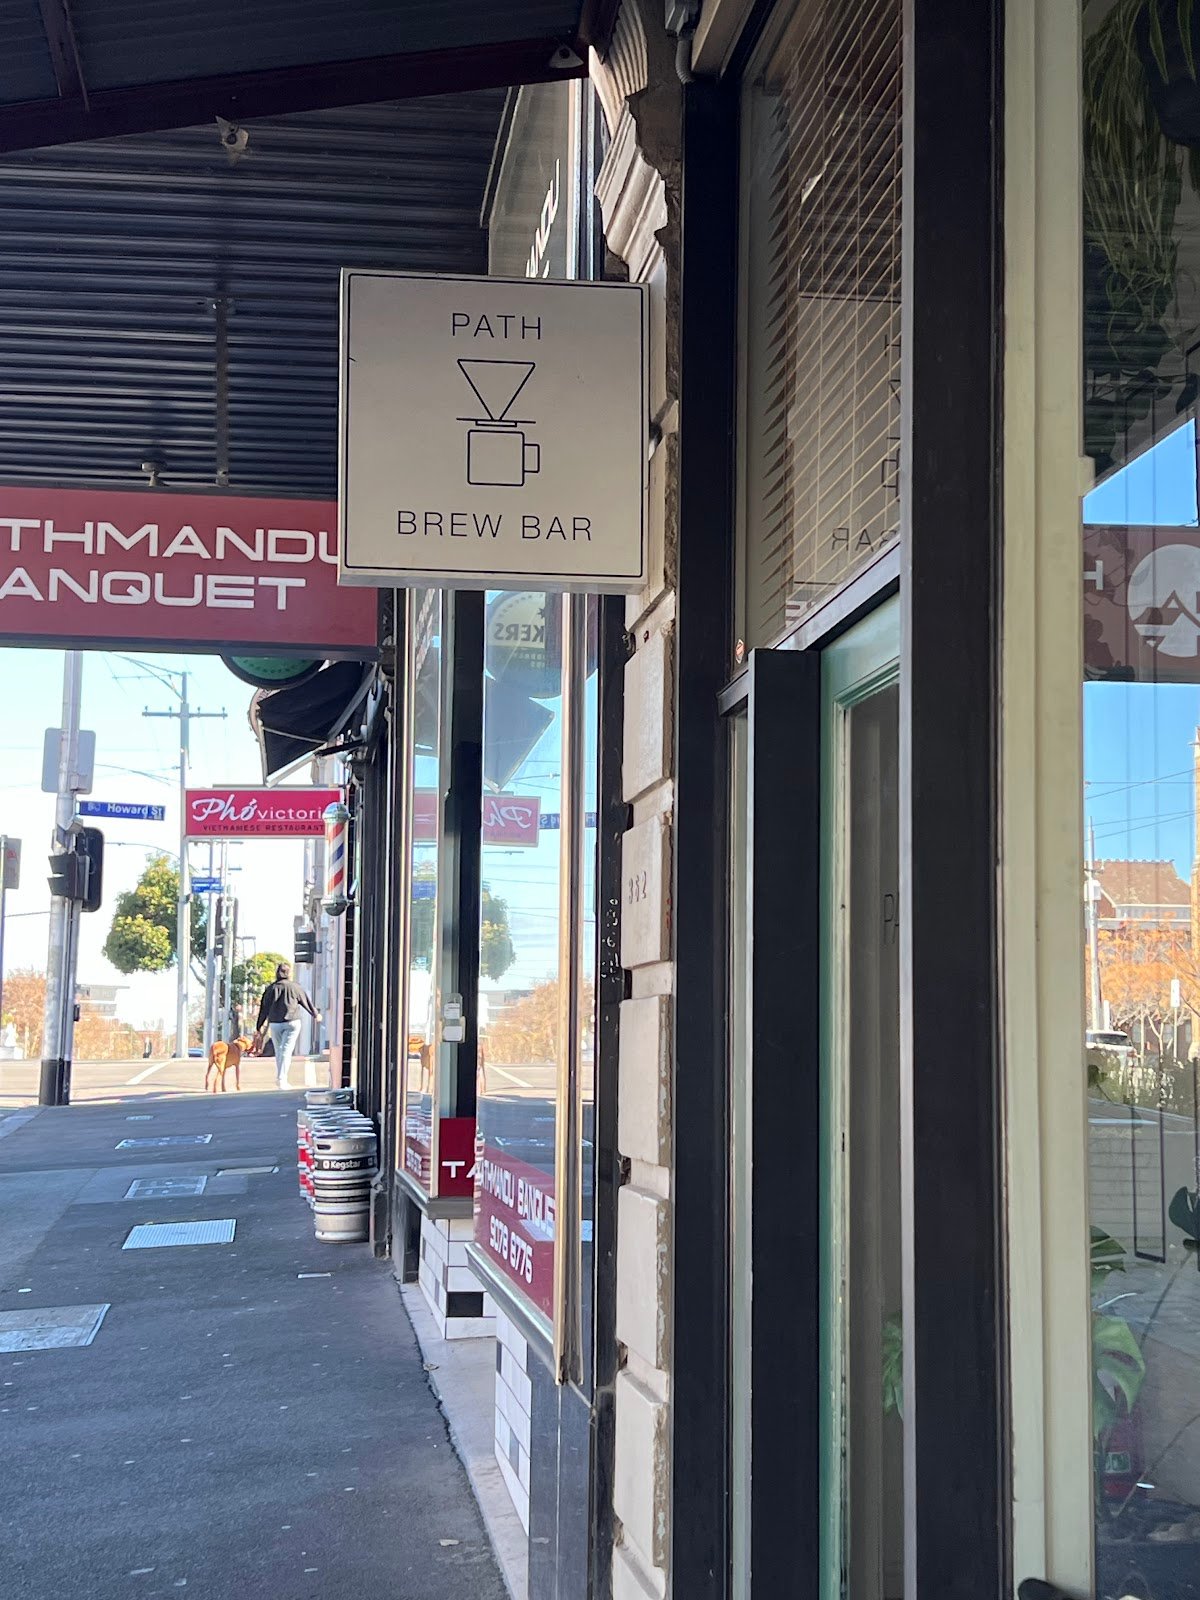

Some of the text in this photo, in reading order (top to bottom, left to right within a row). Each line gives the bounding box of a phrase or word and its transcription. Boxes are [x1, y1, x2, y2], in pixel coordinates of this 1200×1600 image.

[452, 313, 541, 340] PATH
[397, 510, 592, 541] BREW BAR
[0, 567, 306, 610] ANQUET
[107, 803, 163, 816] Howard St
[257, 806, 323, 820] victori
[203, 823, 324, 832] VIETNAMESE RESTAURANT
[330, 1160, 361, 1171] Kegstar
